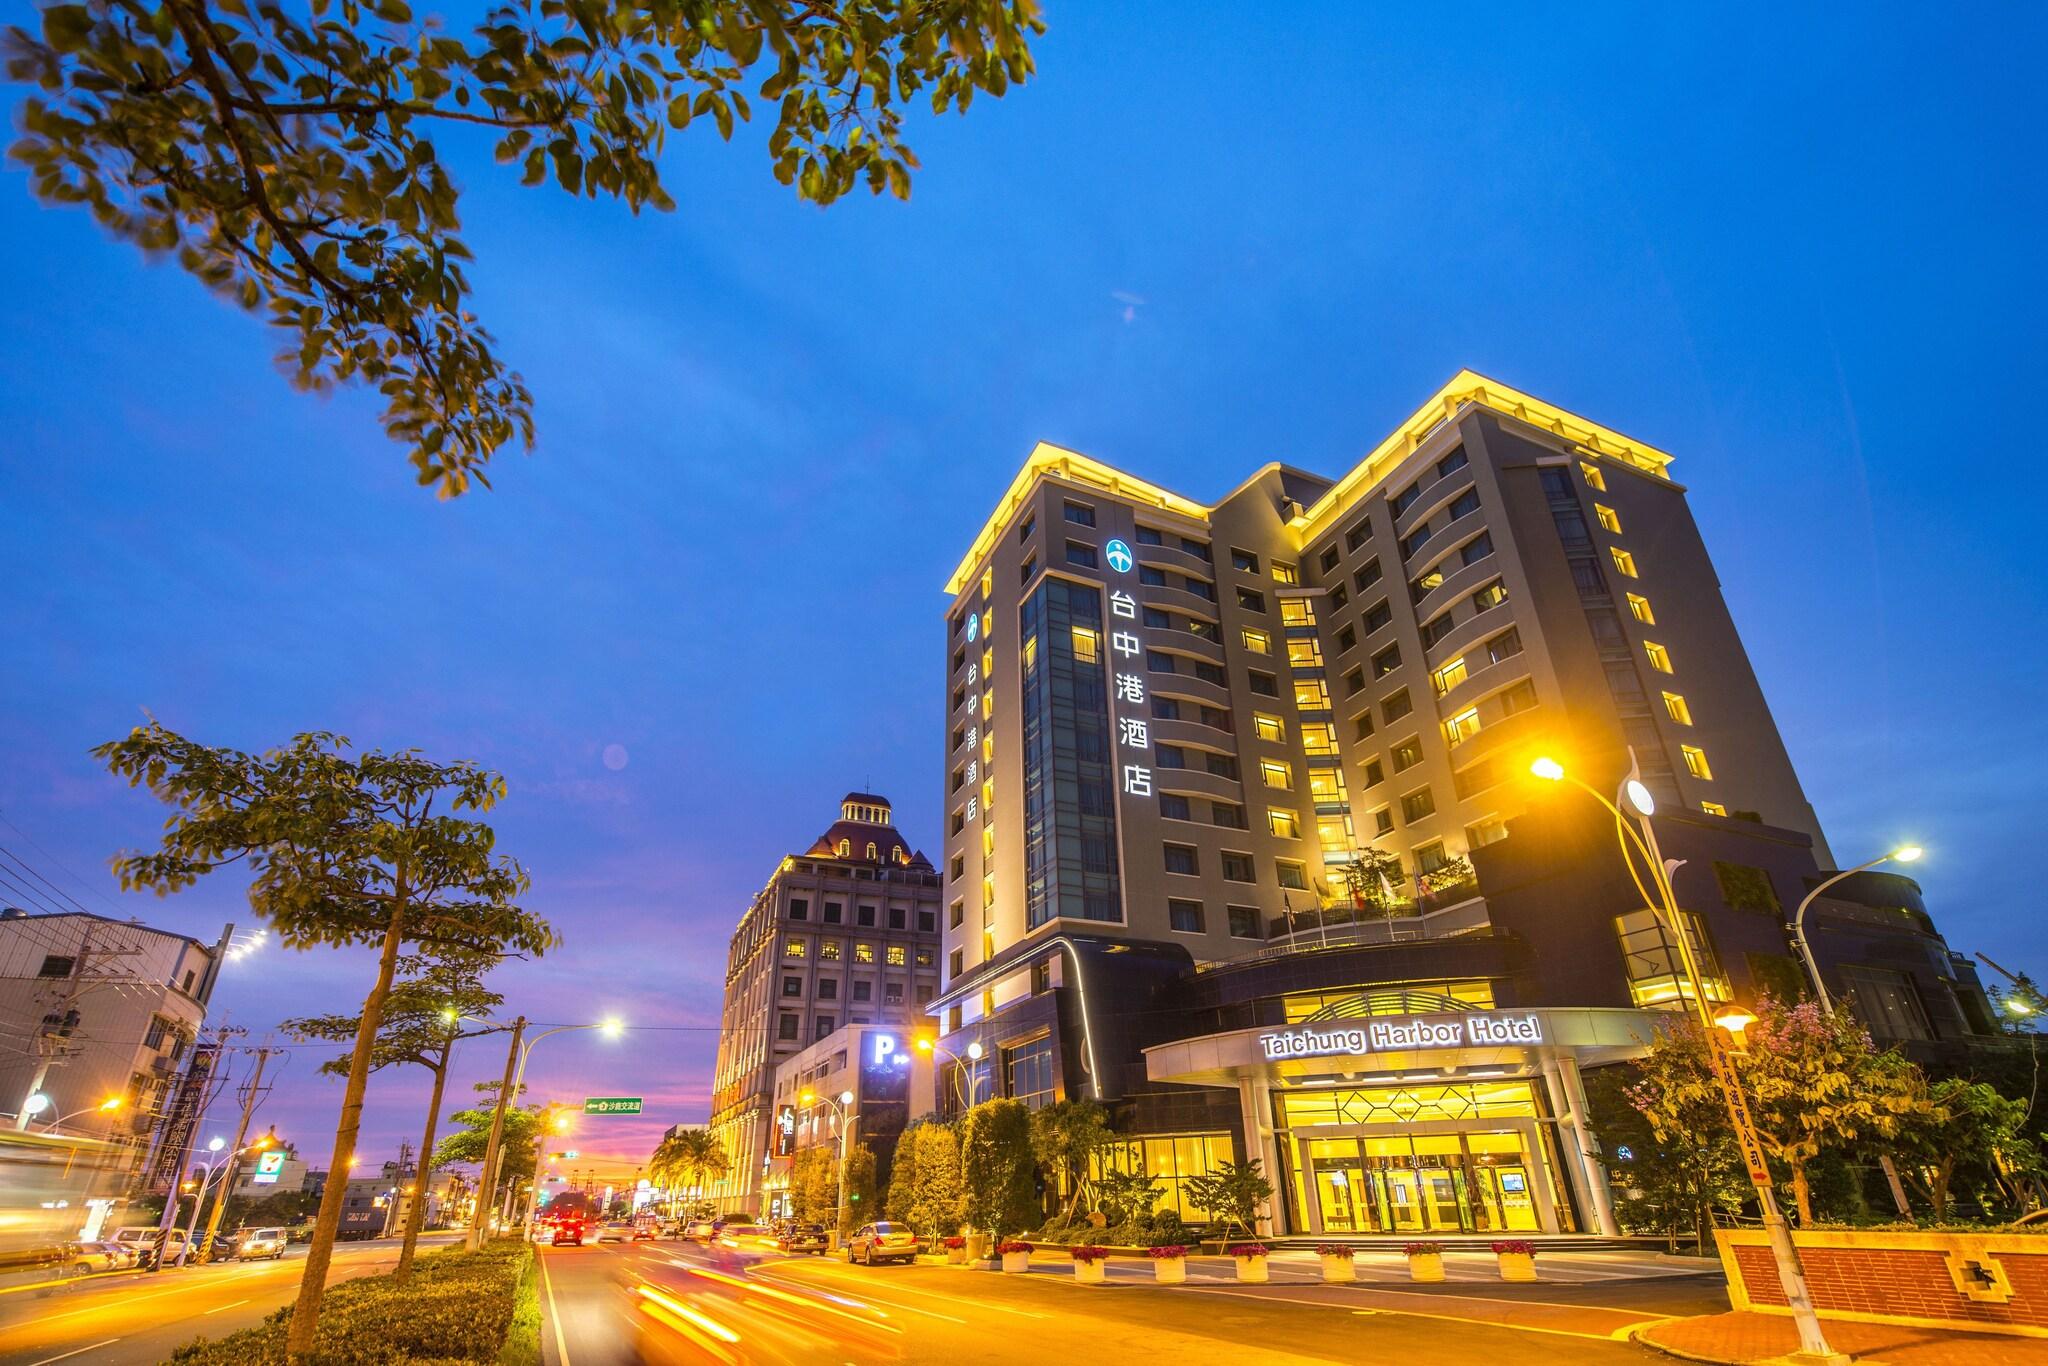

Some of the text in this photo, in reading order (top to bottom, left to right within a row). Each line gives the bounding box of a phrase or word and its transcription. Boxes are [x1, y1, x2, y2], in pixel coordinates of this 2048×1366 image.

[967, 663, 978, 823] 台中港酒店
[1109, 589, 1152, 798] 台中港酒店
[874, 1034, 896, 1064] P
[1262, 1017, 1543, 1057] Taichung Harbor Hotel
